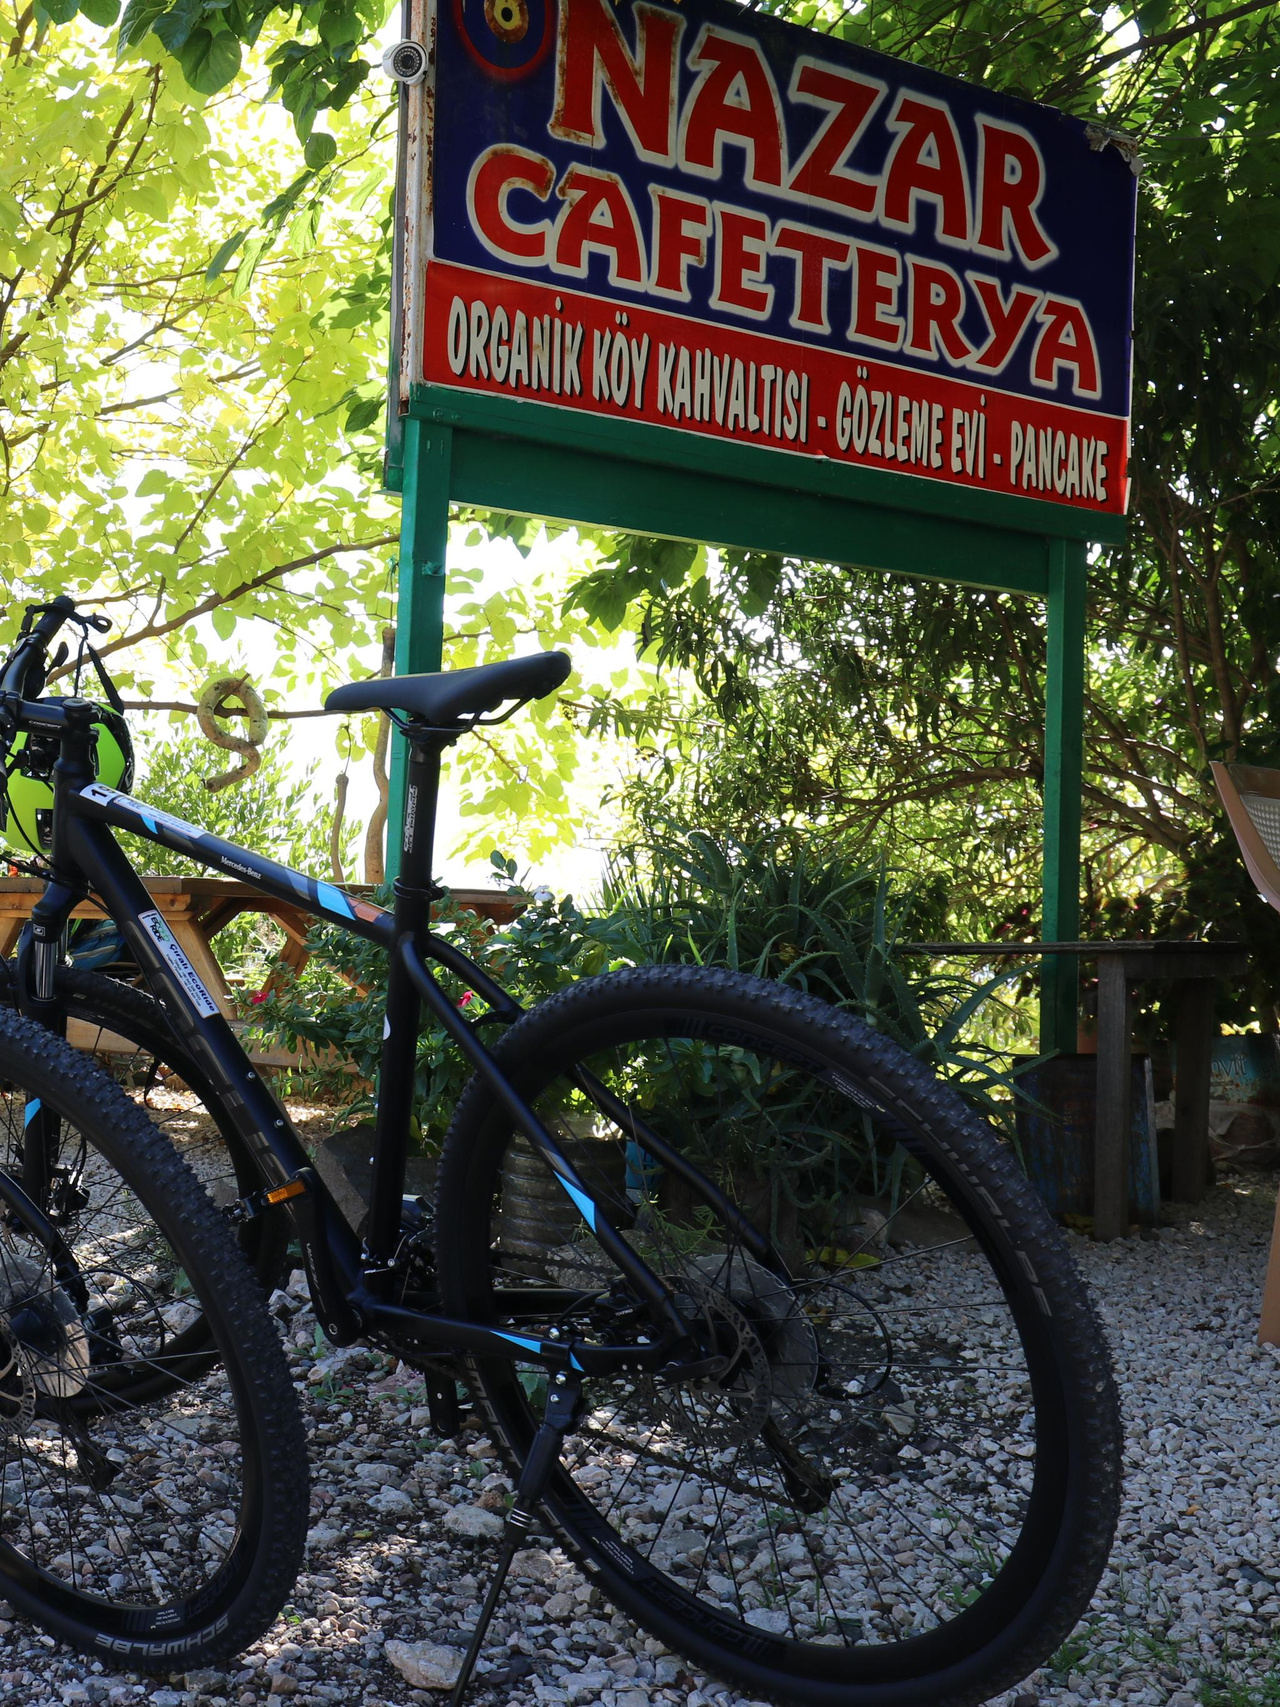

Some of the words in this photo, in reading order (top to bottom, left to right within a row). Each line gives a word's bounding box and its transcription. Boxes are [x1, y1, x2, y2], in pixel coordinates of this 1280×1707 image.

[548, 0, 1060, 270] NAZAR
[465, 142, 1103, 400] CAFETERYA
[447, 295, 585, 396] ORGANİK
[592, 310, 651, 410] KÖY
[657, 341, 810, 444] KAHVALTISI
[835, 364, 946, 470] GÖZLEME
[951, 393, 987, 479] EVİ
[1010, 420, 1109, 502] PANCAKE
[221, 855, 262, 880] Mercedes-Benz
[94, 1613, 230, 1657] SCHWALBE
